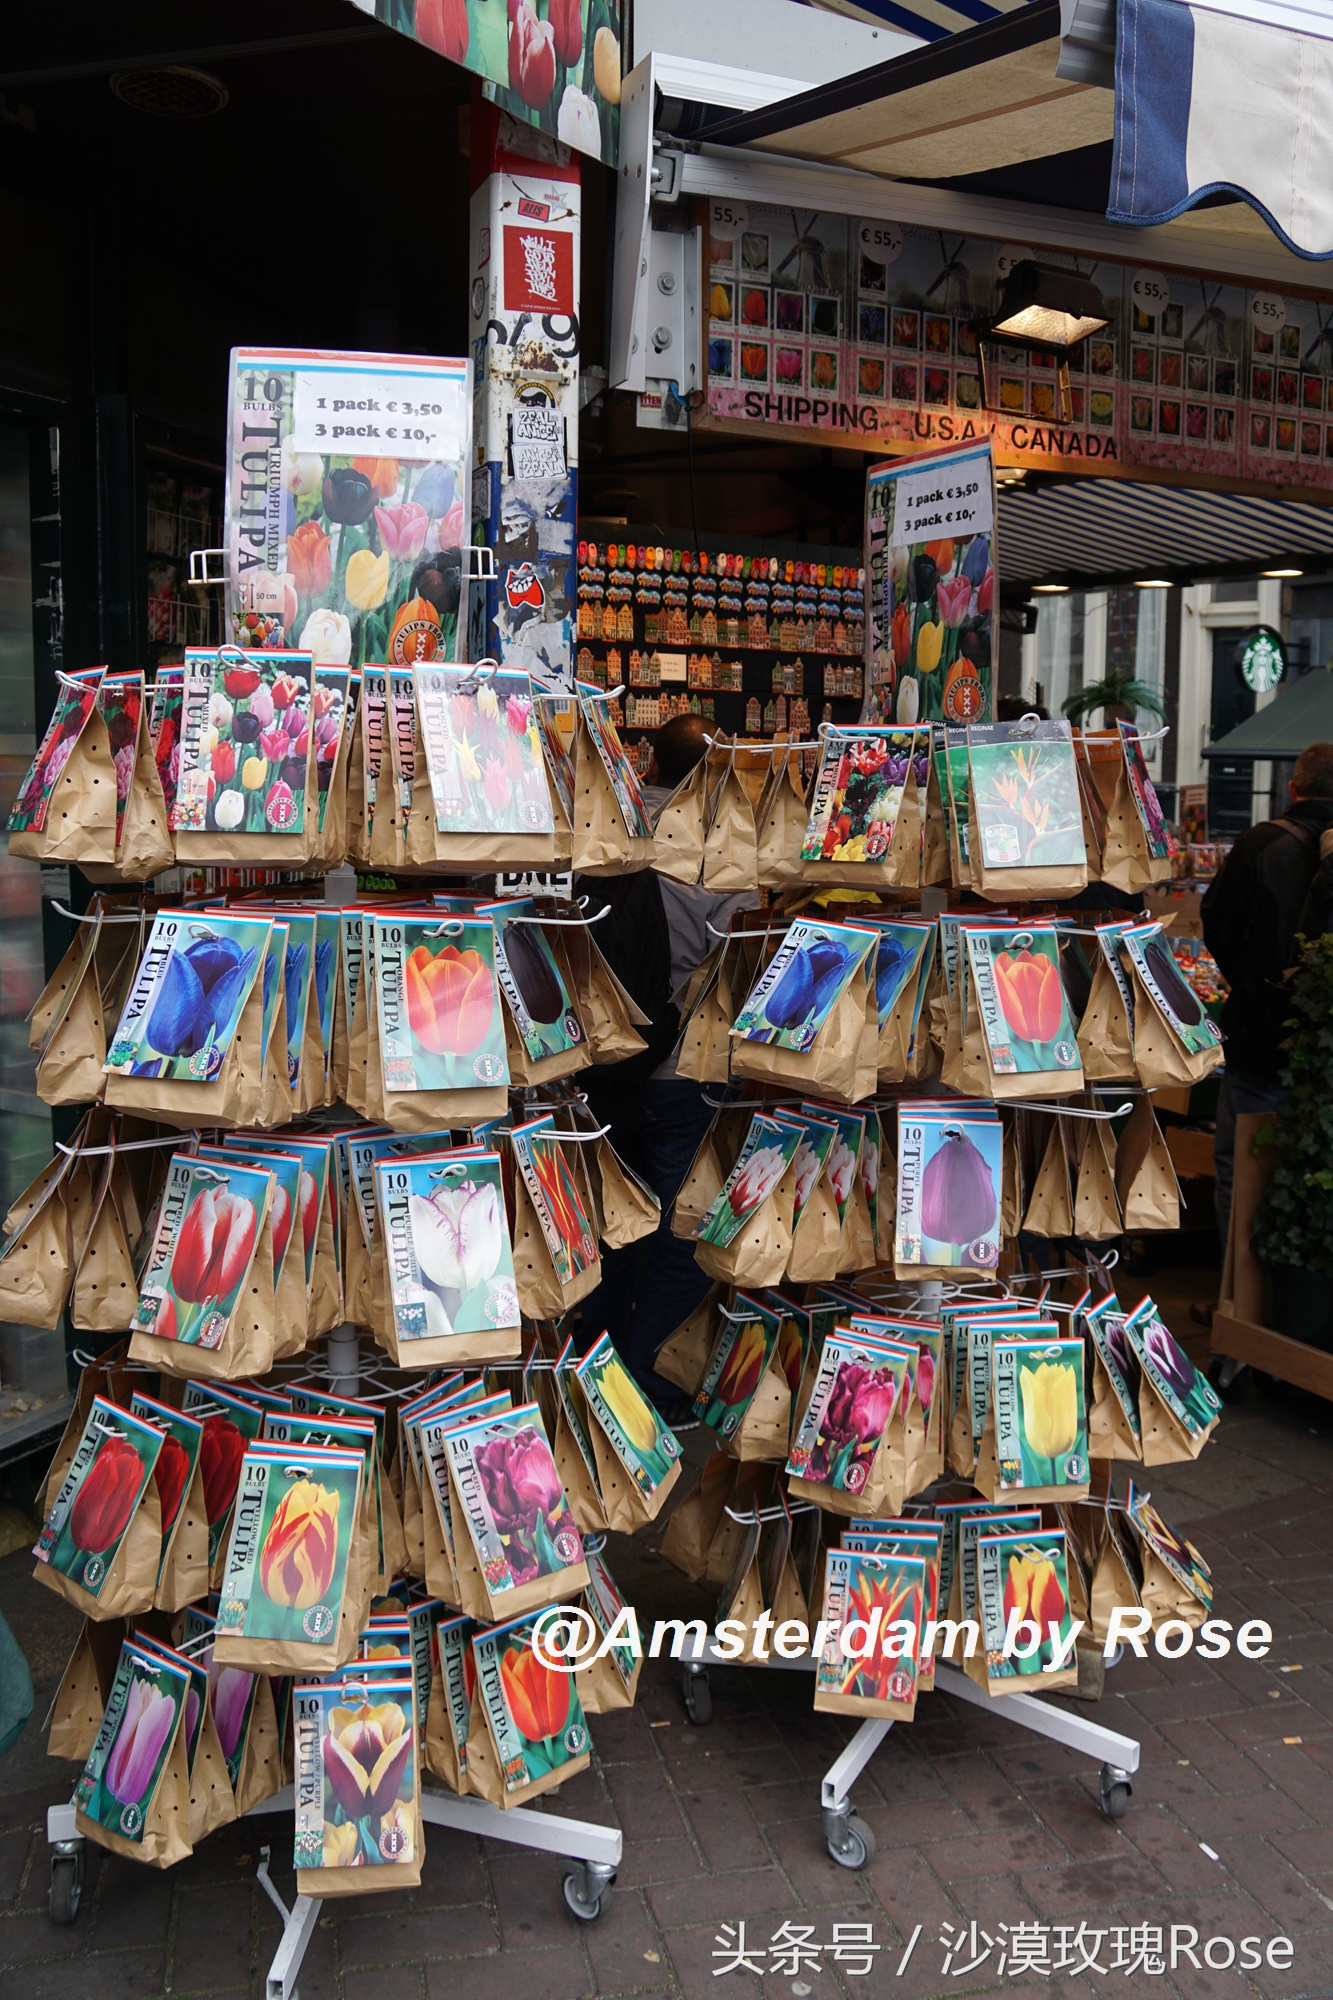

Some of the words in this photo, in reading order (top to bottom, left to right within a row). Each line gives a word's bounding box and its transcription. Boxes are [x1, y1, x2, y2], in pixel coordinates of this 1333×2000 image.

[522, 202, 544, 217] ALIS
[861, 228, 870, 243] €
[874, 230, 902, 250] 55,-
[1133, 281, 1141, 294] €
[1144, 282, 1168, 300] 55,-
[1253, 300, 1261, 314] €
[1263, 301, 1285, 319] 55,-
[244, 376, 283, 403] 10
[243, 402, 283, 412] BULBS
[316, 397, 327, 409] 1
[333, 397, 381, 413] pack
[386, 401, 398, 413] €
[401, 402, 443, 417] 3,50
[315, 423, 327, 437] 3
[332, 423, 381, 439] pack
[385, 427, 398, 439] €
[402, 428, 437, 444] 10,-
[744, 390, 879, 431] SHIPPING
[1011, 423, 1118, 460] CANADA
[238, 416, 282, 574] TULIPA
[267, 449, 282, 519] TRIUMPH
[907, 496, 914, 507] 1
[916, 489, 944, 508] pack
[946, 487, 954, 499] €
[955, 481, 979, 499] 3,50
[871, 486, 891, 510] 10
[904, 520, 911, 532] 3
[914, 513, 942, 532] pack
[945, 511, 953, 523] €
[955, 509, 976, 523] 10,-
[266, 520, 280, 572] MIXED
[256, 592, 265, 600] 50
[870, 520, 888, 652] TULIPA
[396, 621, 426, 646] TULIPS
[428, 623, 446, 646] FROM
[189, 662, 211, 679] 10
[420, 674, 441, 690] 10
[367, 677, 386, 692] 10
[394, 679, 413, 694] 10
[948, 676, 969, 700] TULIPS
[969, 677, 985, 698] FROM
[183, 686, 210, 774] TULIPA
[202, 704, 210, 733] MIXED
[970, 724, 994, 732] REGINAE
[366, 701, 386, 780] TULIPA
[394, 703, 415, 783] TULIPA
[423, 697, 448, 777] TULIPA
[814, 753, 839, 816] TULIPA
[155, 922, 178, 936] 10
[380, 927, 401, 943] 10
[792, 926, 808, 938] 10
[971, 938, 988, 951] 10
[156, 959, 166, 979] BLUE
[494, 936, 521, 1013] TULIPA
[754, 942, 800, 997] TULIPA
[126, 943, 172, 1021] TULIPA
[381, 950, 401, 1036] TULIPA
[396, 965, 405, 1003] ORANGE
[974, 957, 999, 1027] TULIPA
[1135, 953, 1172, 1016] TULIPA
[750, 1122, 761, 1136] 10
[904, 1127, 921, 1141] 10
[172, 1166, 190, 1184] 10
[718, 1138, 757, 1199] TULIPA
[170, 1182, 189, 1190] BULBS
[386, 1173, 407, 1189] 10
[901, 1146, 921, 1216] TULIPA
[522, 1157, 552, 1233] TULIPA
[150, 1191, 187, 1273] TULIPA
[388, 1196, 411, 1283] TULIPA
[973, 1333, 989, 1346] 10
[824, 1346, 840, 1361] 10
[998, 1352, 1013, 1365] 10
[972, 1351, 989, 1420] TULIPA
[803, 1366, 837, 1430] TULIPA
[998, 1370, 1014, 1441] TULIPA
[90, 1409, 106, 1424] 10
[591, 1388, 627, 1459] TULIPA
[268, 1426, 287, 1441] 10
[426, 1427, 442, 1443] 10
[450, 1438, 469, 1455] 10
[454, 1450, 471, 1461] BULBS
[57, 1431, 99, 1505] TULIPA
[246, 1465, 266, 1482] 10
[245, 1480, 266, 1488] BULBS
[456, 1458, 490, 1542] TULIPA
[229, 1489, 264, 1576] TULIPA
[964, 1527, 978, 1539] 10
[982, 1546, 998, 1559] 10
[831, 1560, 848, 1573] 10
[963, 1543, 978, 1610] TULIPA
[982, 1564, 999, 1632] TULIPA
[411, 1612, 429, 1627] 10
[443, 1628, 460, 1645] 10
[121, 1651, 134, 1669] 10
[478, 1641, 495, 1658] 10
[413, 1630, 431, 1704] TULIPA
[446, 1646, 465, 1725] TULIPA
[299, 1699, 319, 1714] 10
[482, 1660, 510, 1743] TULIPA
[95, 1674, 130, 1753] TULIPA
[299, 1722, 320, 1809] TULIPA
